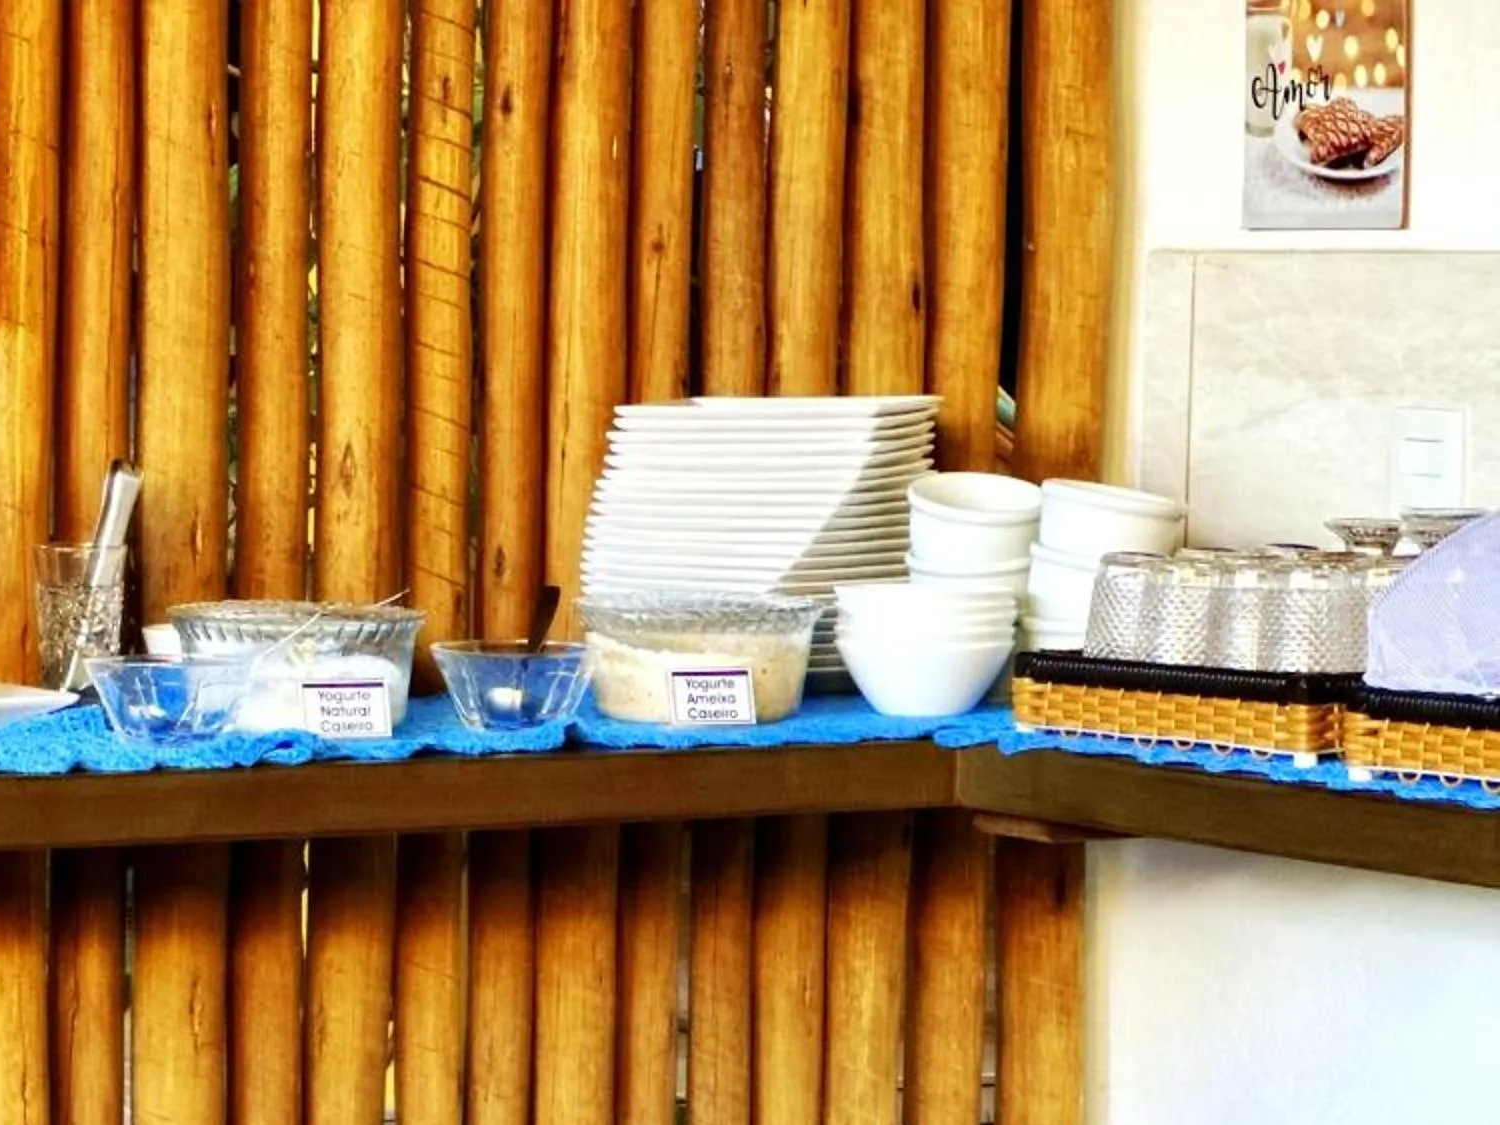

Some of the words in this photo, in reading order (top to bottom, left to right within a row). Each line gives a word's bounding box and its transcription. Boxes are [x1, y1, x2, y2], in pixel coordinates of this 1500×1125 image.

[1251, 62, 1332, 120] Amor
[685, 678, 736, 692] Yogurte
[317, 690, 372, 704] Yogurte
[320, 706, 371, 717] Natural
[687, 707, 739, 719] Caseiro
[320, 720, 374, 733] Caseiro
